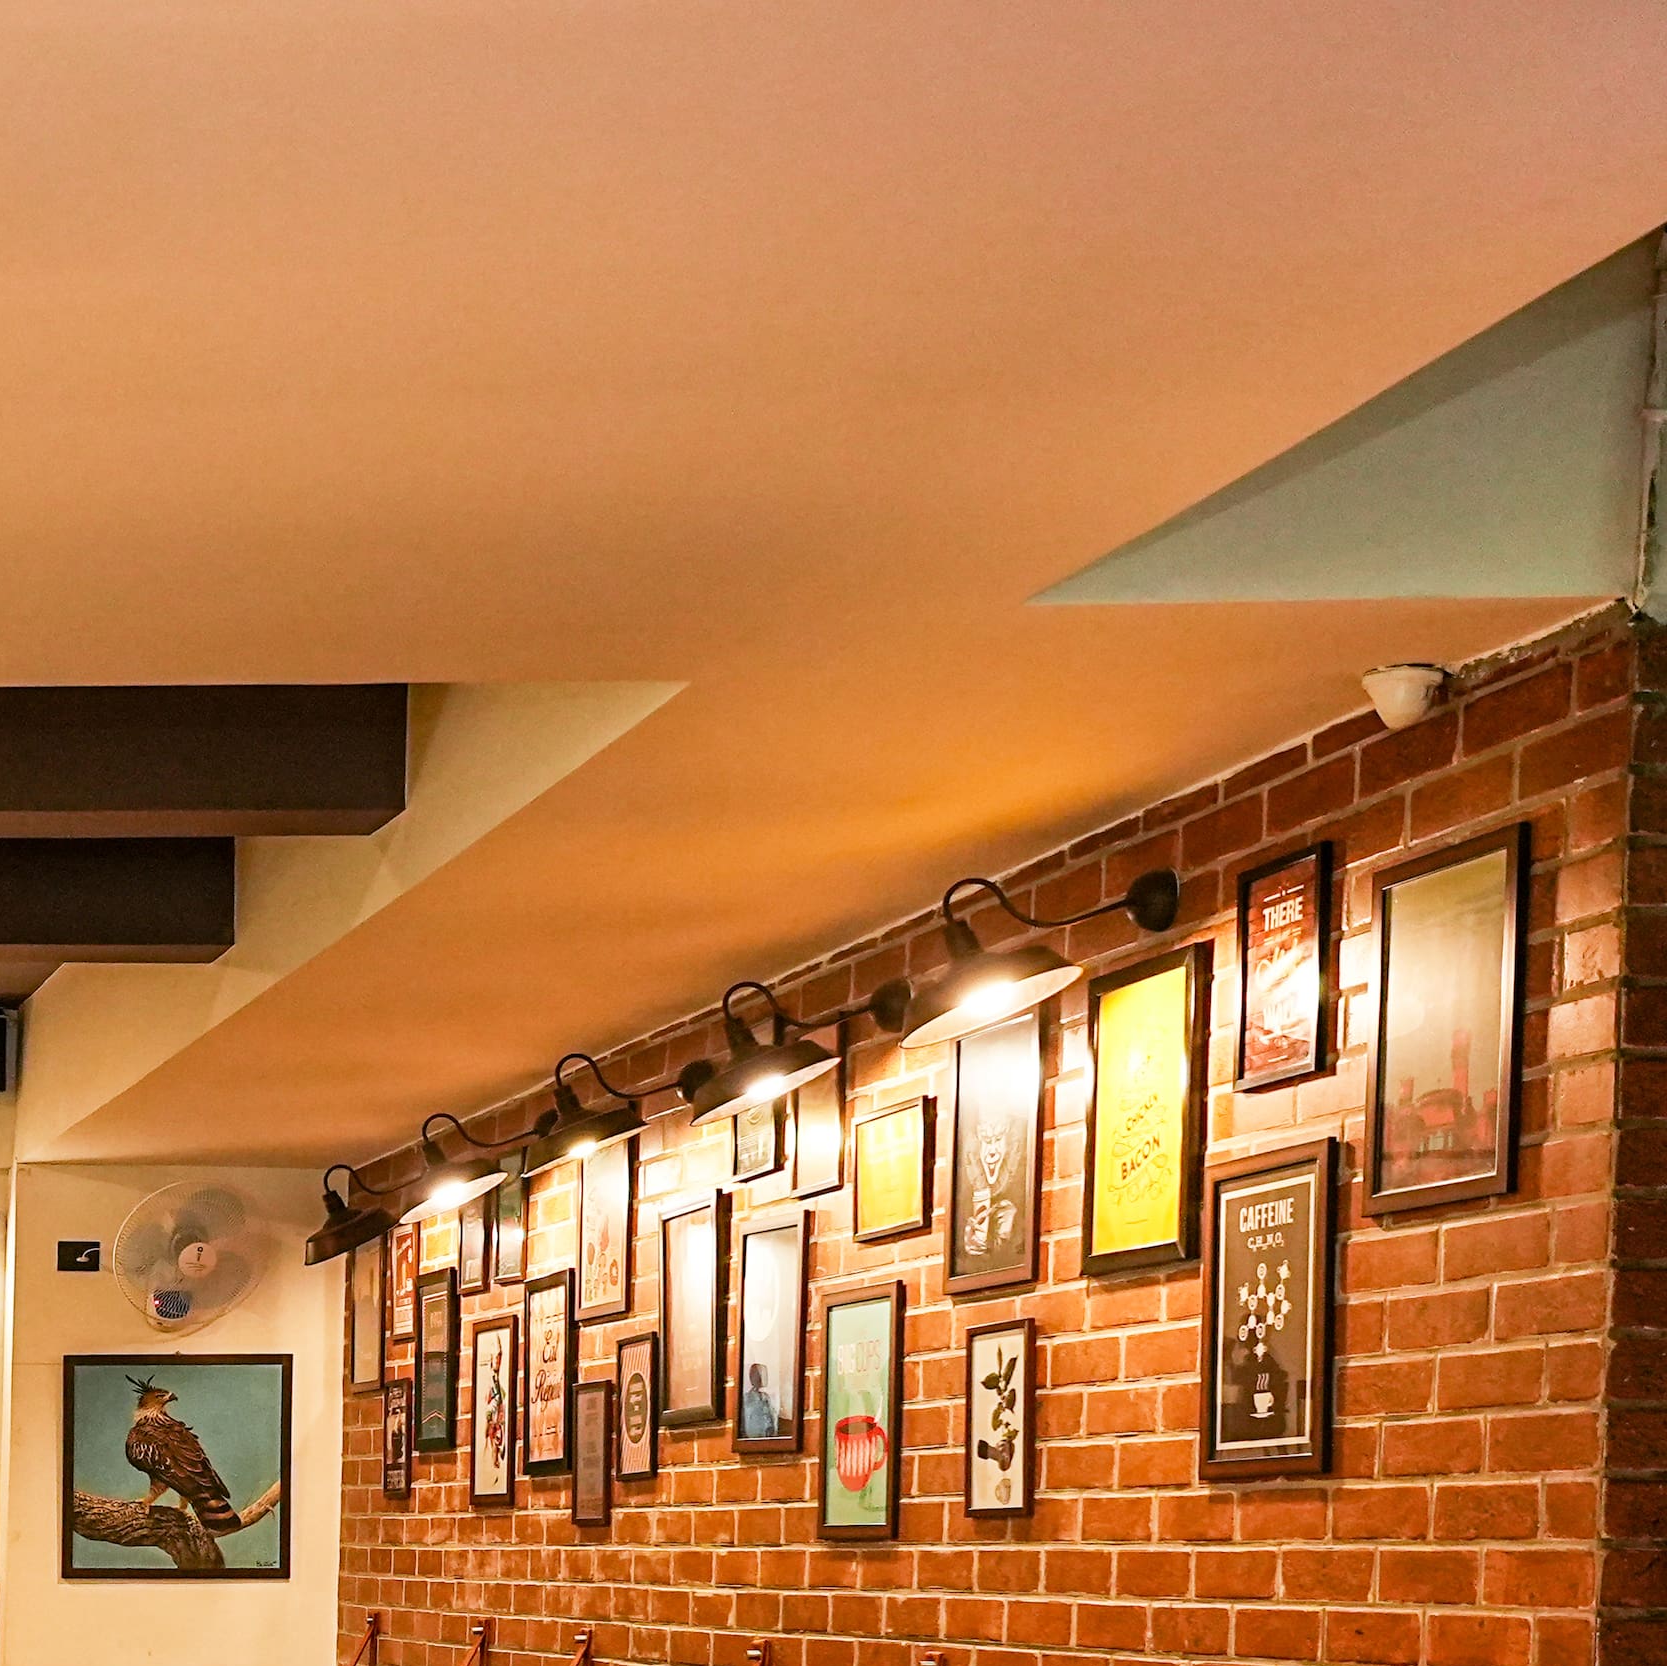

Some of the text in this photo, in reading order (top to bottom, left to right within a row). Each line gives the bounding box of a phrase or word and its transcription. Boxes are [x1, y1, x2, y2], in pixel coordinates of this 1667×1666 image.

[1262, 896, 1304, 933] THERE
[1120, 1135, 1161, 1181] BACON
[1238, 1197, 1295, 1233] CAFFEINE
